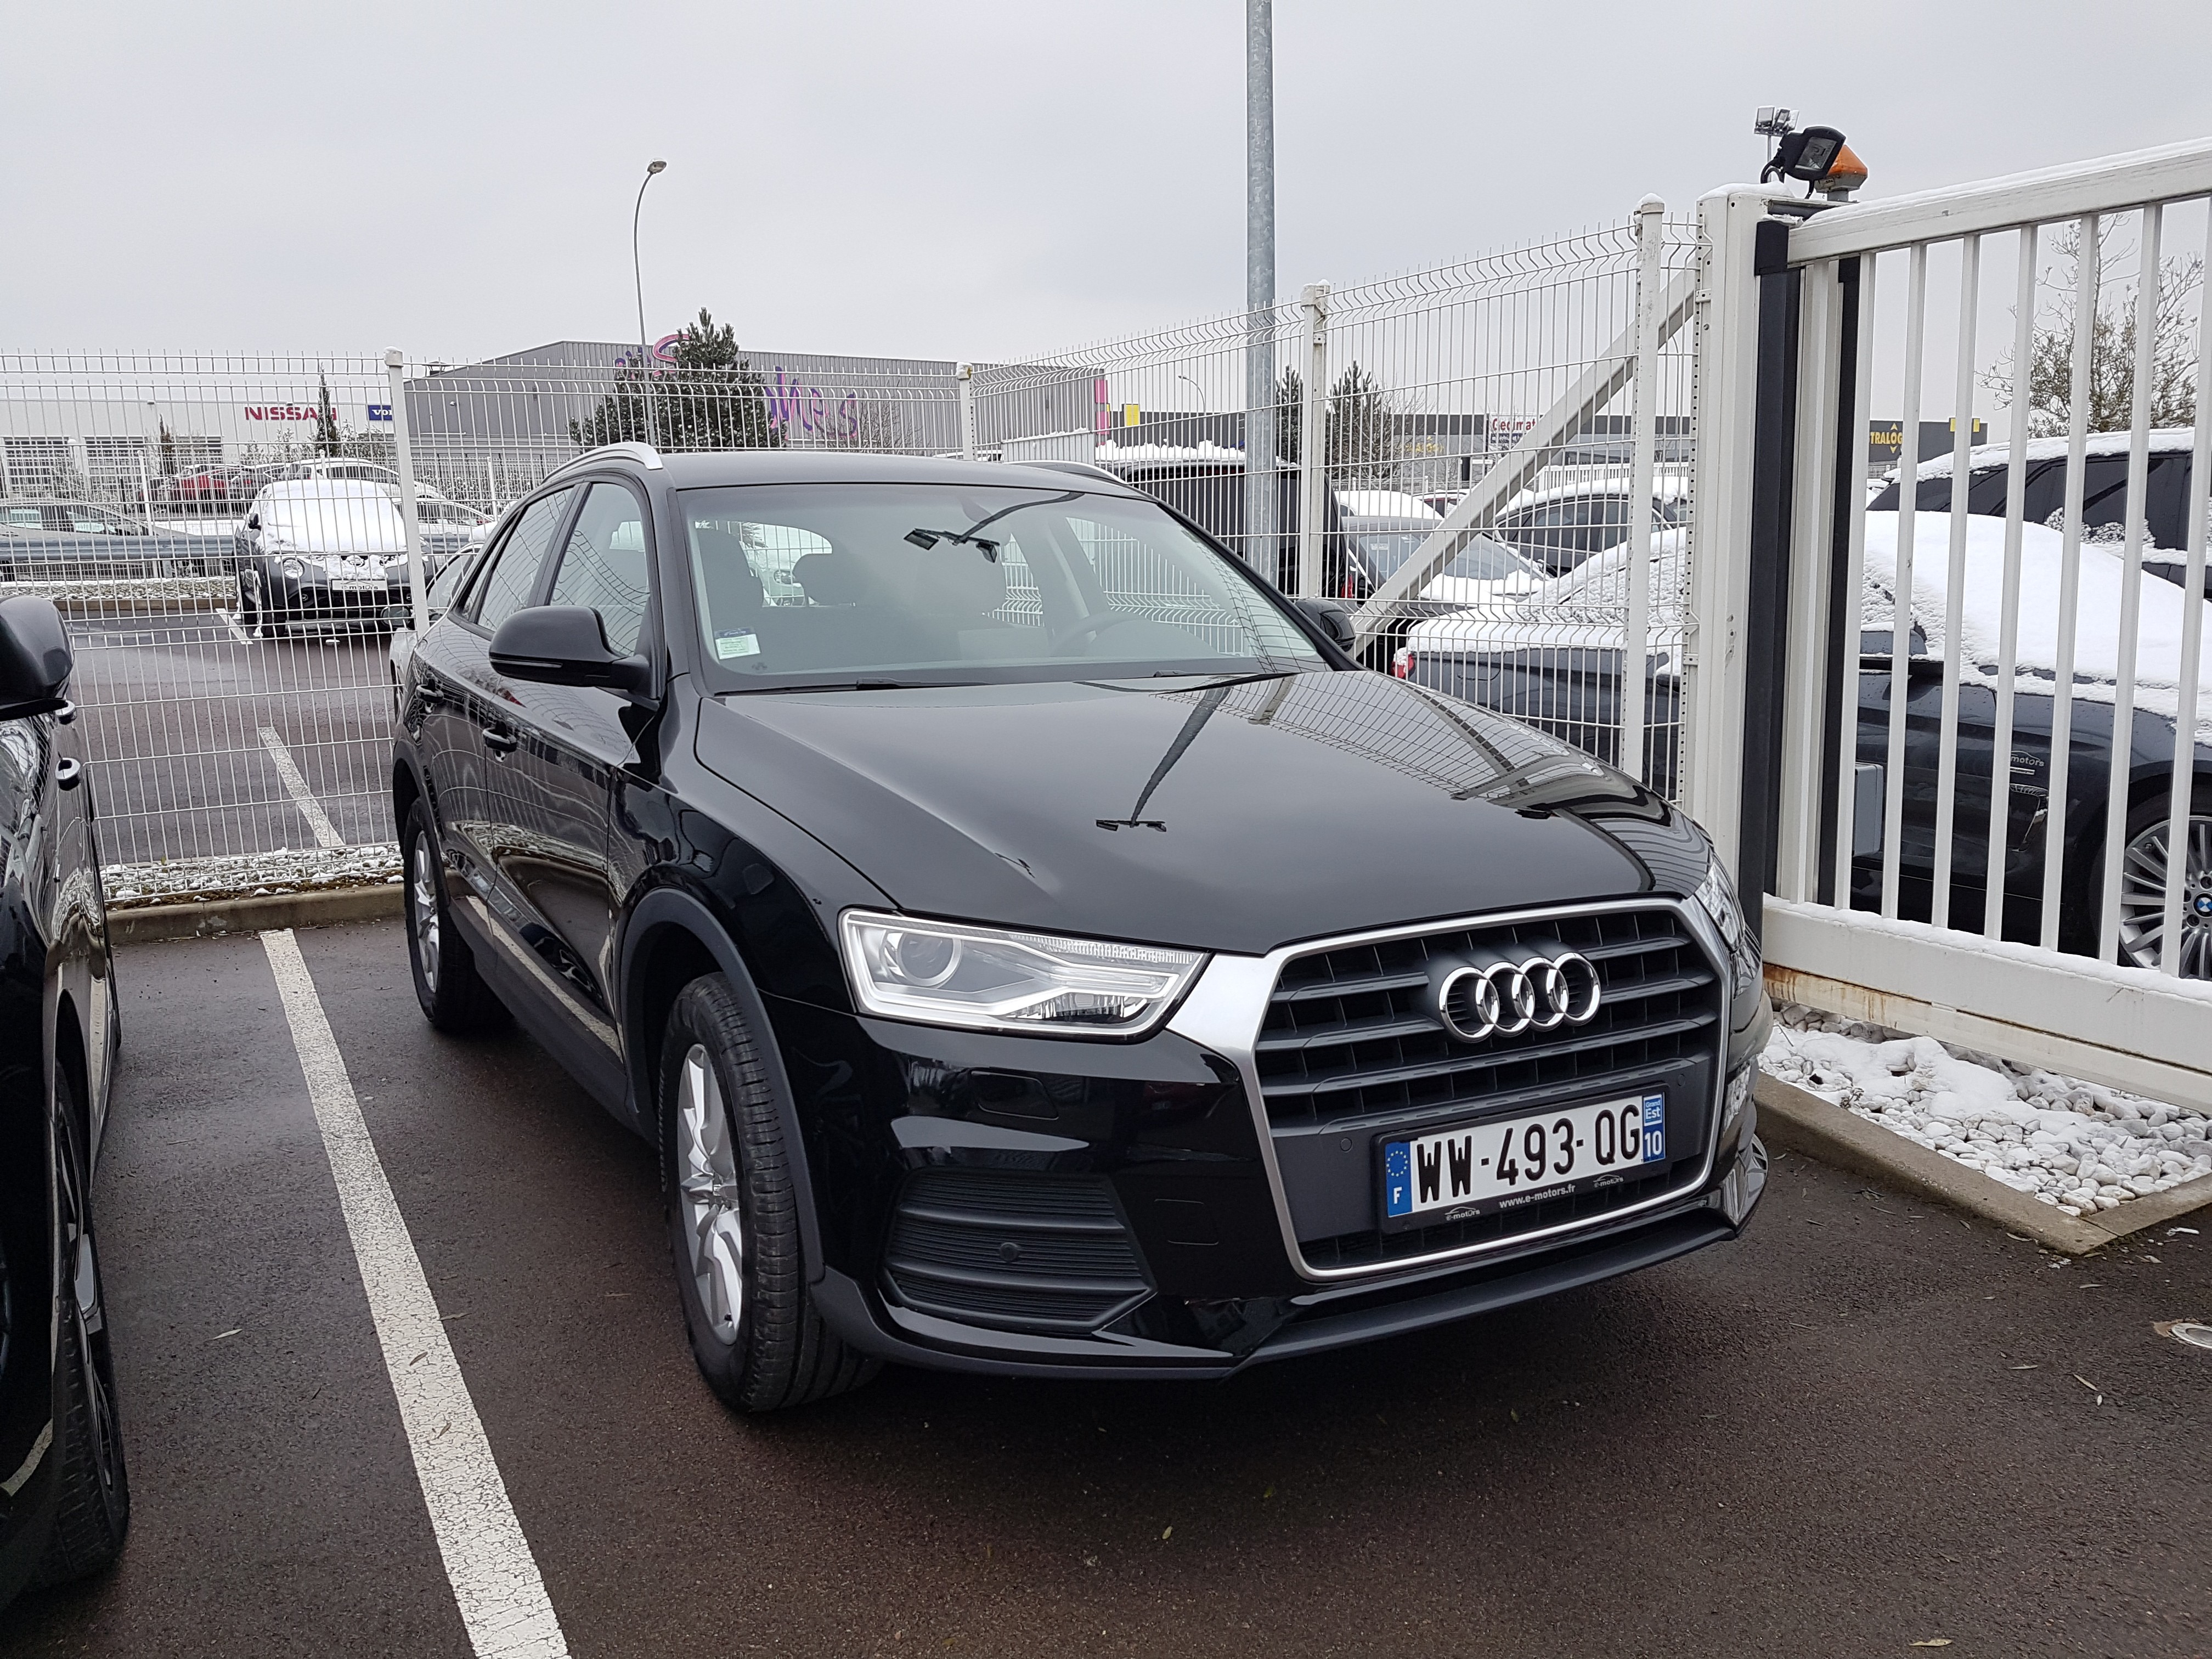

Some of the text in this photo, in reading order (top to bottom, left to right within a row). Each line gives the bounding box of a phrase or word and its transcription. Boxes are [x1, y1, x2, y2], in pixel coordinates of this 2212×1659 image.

[1870, 432, 1903, 444] TRALOG
[1646, 1100, 1661, 1108] Grand
[1646, 1107, 1661, 1119] Est
[1645, 1131, 1662, 1157] 10
[1417, 1105, 1640, 1203] WW-493-QG
[1393, 1187, 1402, 1204] F
[1499, 1183, 1576, 1209] www.e-motors.fr
[1446, 1209, 1481, 1221] e-motors
